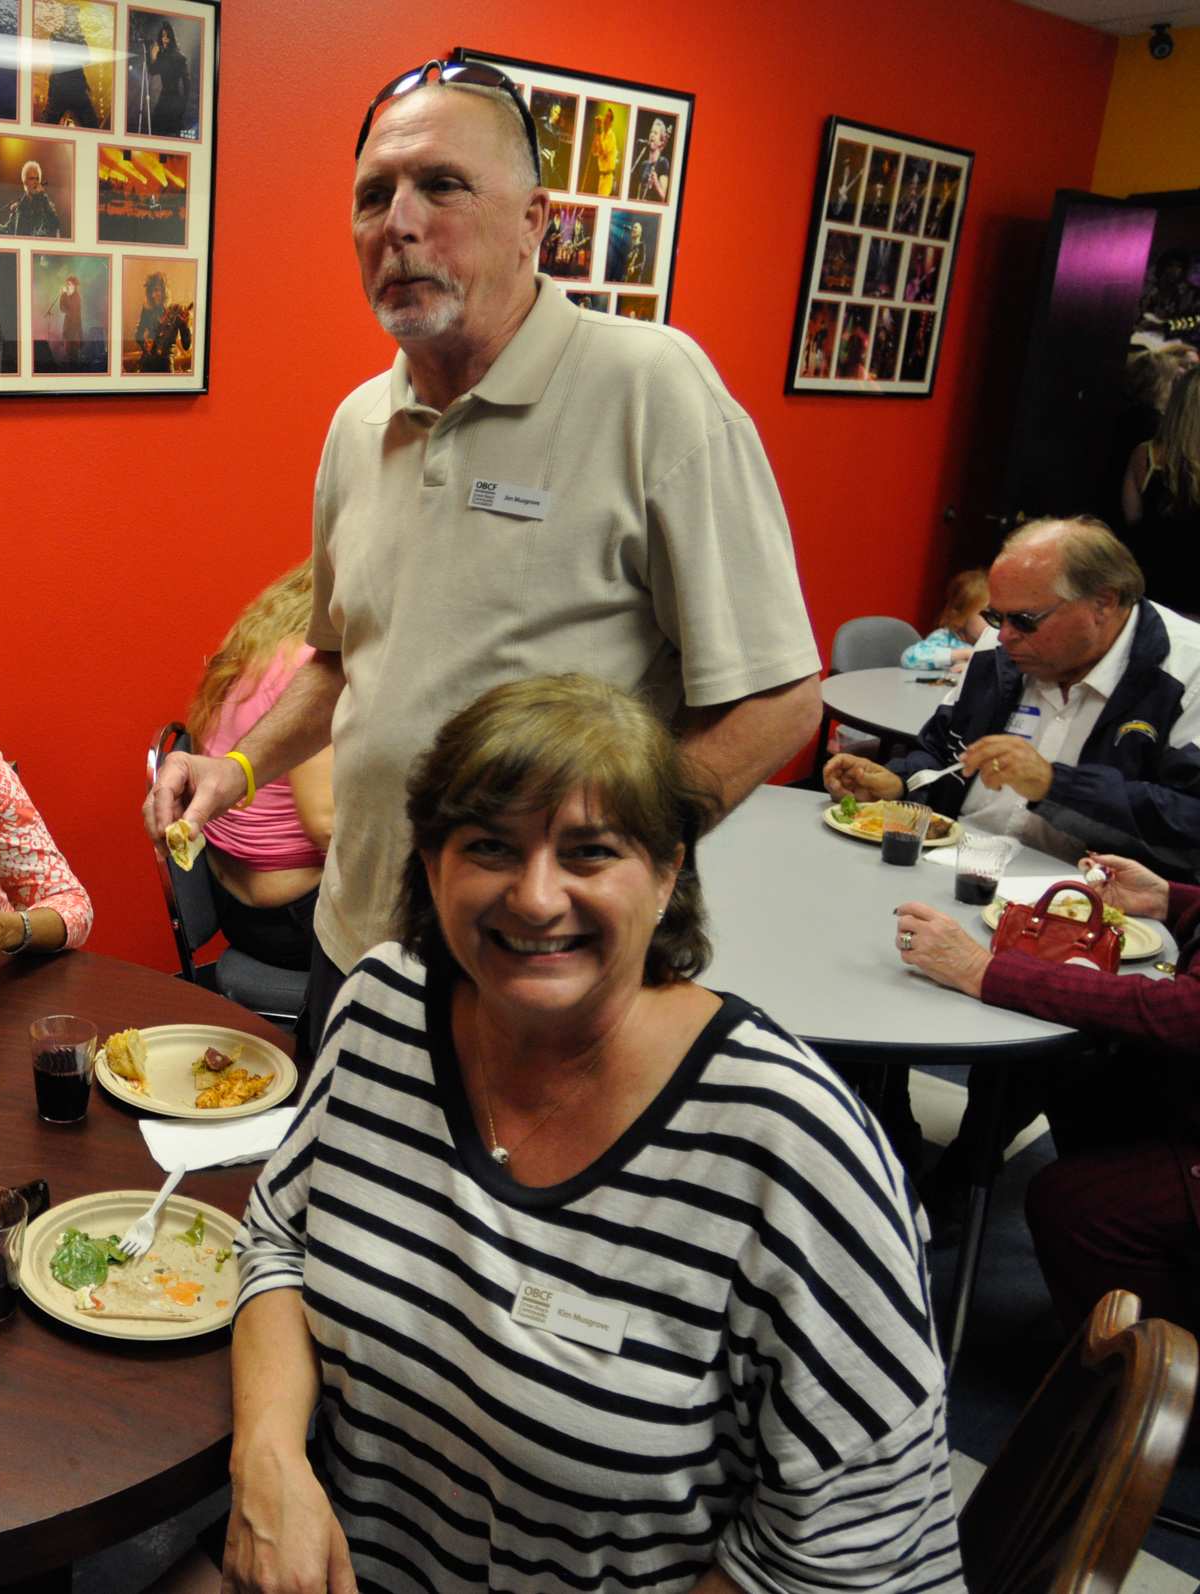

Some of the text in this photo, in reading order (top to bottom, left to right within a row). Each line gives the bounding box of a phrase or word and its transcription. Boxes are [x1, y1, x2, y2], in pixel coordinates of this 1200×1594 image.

[476, 481, 498, 490] OBCF
[524, 1286, 553, 1300] OBCF
[558, 1308, 572, 1320] Kim
[573, 1313, 609, 1331] Musgrove
